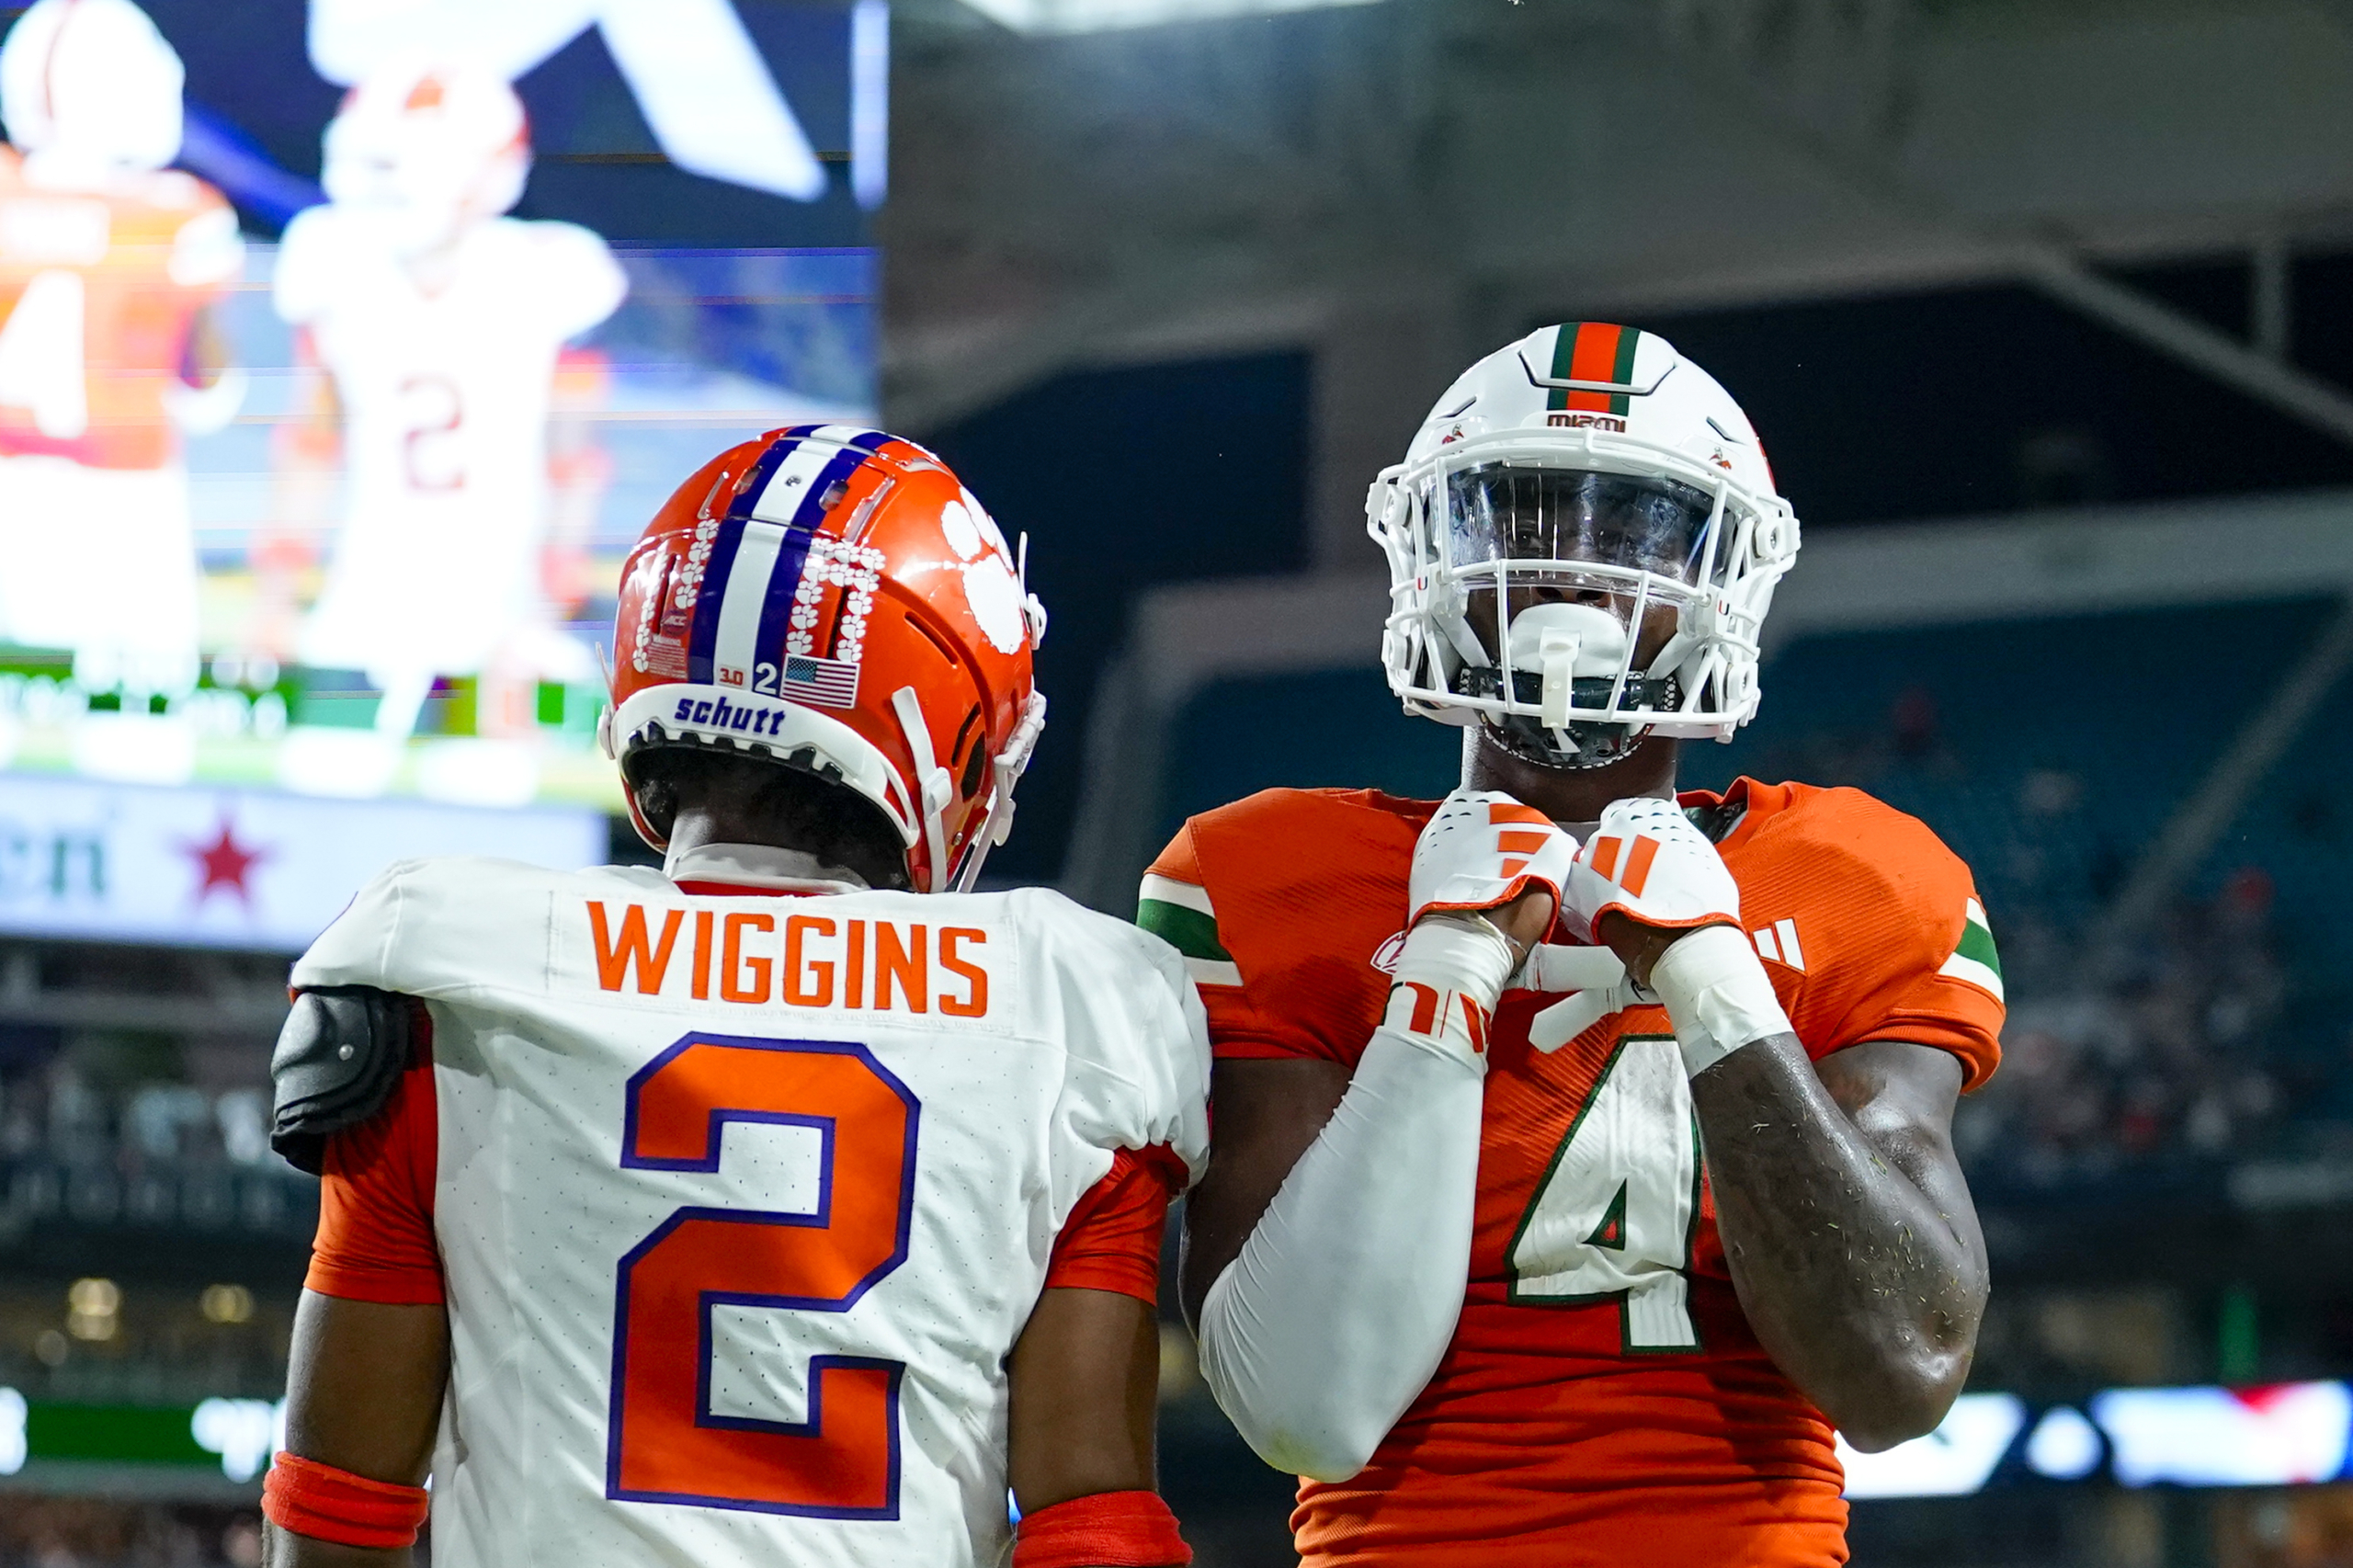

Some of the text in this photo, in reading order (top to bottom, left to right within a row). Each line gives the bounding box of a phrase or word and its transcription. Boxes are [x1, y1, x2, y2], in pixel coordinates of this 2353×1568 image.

[674, 696, 786, 736] schutt
[719, 667, 745, 687] 3.0
[755, 662, 778, 696] 2
[585, 901, 989, 1018] WIGGINS
[1504, 1033, 1703, 1355] 4
[606, 1030, 921, 1521] 2
